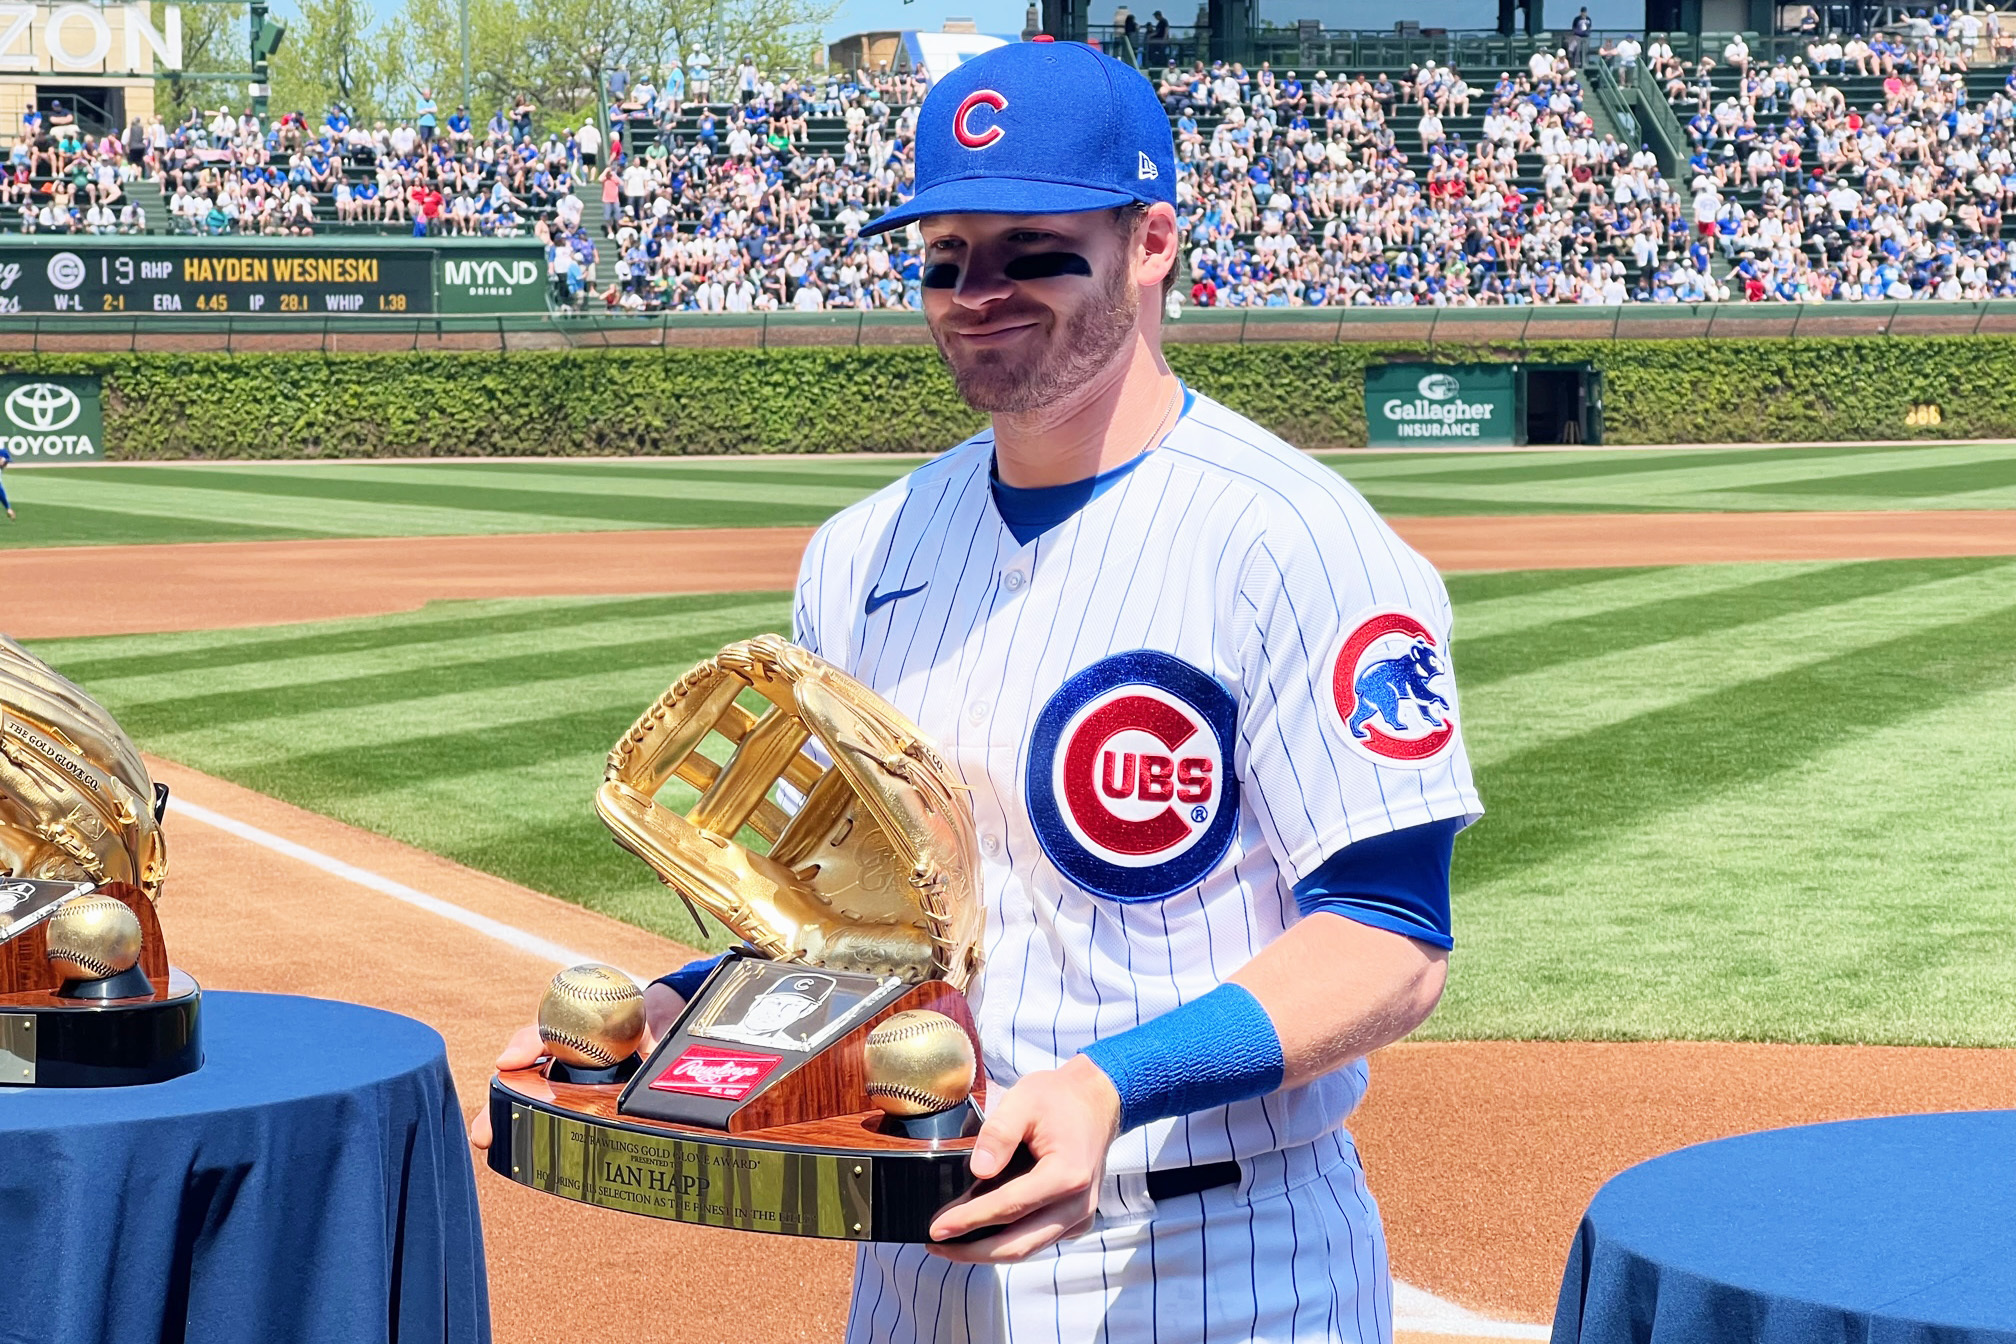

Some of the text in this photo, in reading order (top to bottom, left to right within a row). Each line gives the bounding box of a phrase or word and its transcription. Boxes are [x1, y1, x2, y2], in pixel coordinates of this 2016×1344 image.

[0, 4, 183, 70] ZON
[953, 90, 1008, 150] C
[102, 257, 134, 284] 19
[141, 261, 173, 279] RHP
[184, 258, 268, 282] HAYDEN
[272, 258, 378, 282] WESNESKI
[445, 261, 538, 285] MYND
[54, 294, 406, 311] W-L 2-1 ERA 4.45 IP 28.1 WHIP 1.38
[469, 287, 512, 295] DRINKS
[1383, 399, 1494, 423] Gallagher
[1398, 423, 1480, 437] INSURANCE
[0, 435, 95, 456] TOYOTA
[9, 721, 29, 738] THE
[29, 735, 55, 757] GOLD
[54, 753, 86, 780] GLOVE
[1064, 696, 1213, 855] CUBS
[673, 1060, 759, 1083] Rawlings
[590, 1135, 639, 1155] RAWLINGS
[641, 1145, 670, 1159] GOLD
[604, 1161, 710, 1197] IAN HAPP
[599, 1185, 651, 1205] SELECTION
[653, 1196, 666, 1208] AS
[735, 1207, 748, 1218] IN
[751, 1209, 776, 1221] THE
